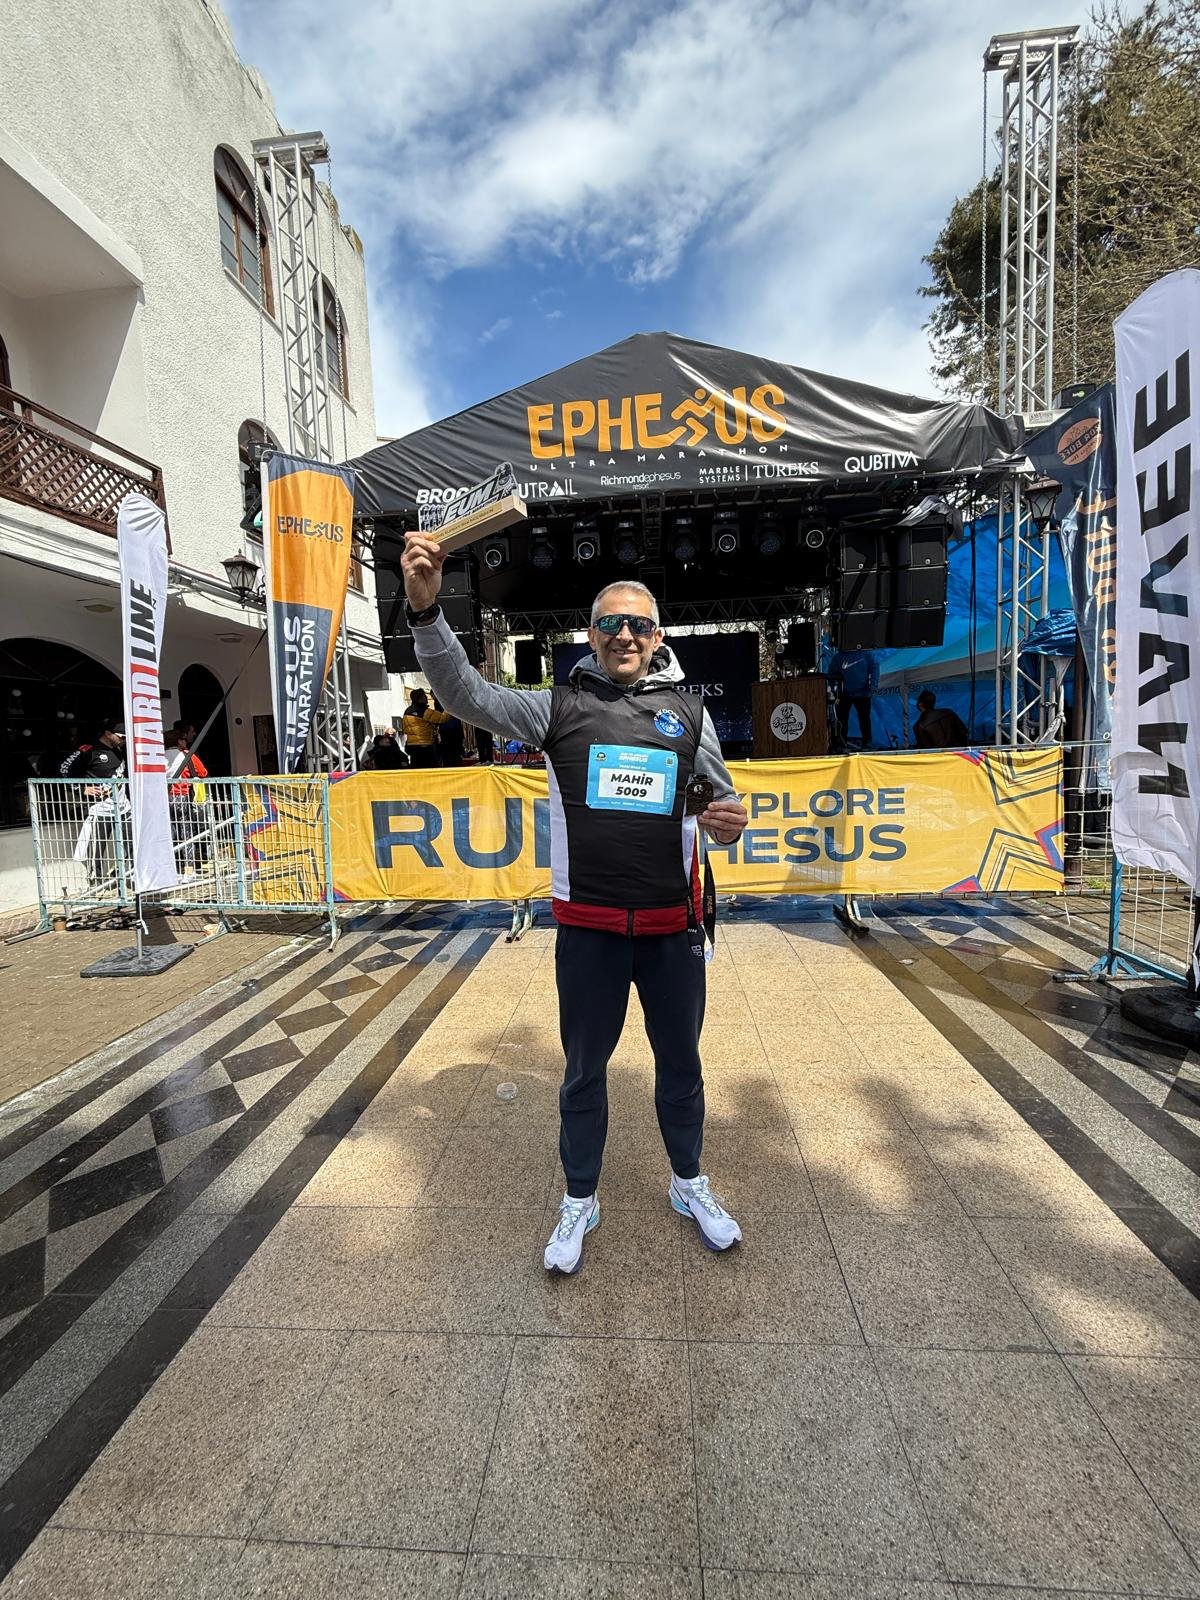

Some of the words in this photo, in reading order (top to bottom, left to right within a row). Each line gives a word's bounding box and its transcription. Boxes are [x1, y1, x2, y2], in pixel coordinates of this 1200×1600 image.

[530, 457, 616, 471] ULTRA
[637, 444, 788, 463] MARATHON
[699, 465, 740, 475] MARBLE
[753, 461, 820, 479] TUREKS
[699, 474, 740, 484] SYSTEMS
[297, 619, 316, 739] MARATHON
[610, 773, 654, 786] MAHİR
[615, 786, 648, 798] 5009
[738, 787, 906, 819] PLORE
